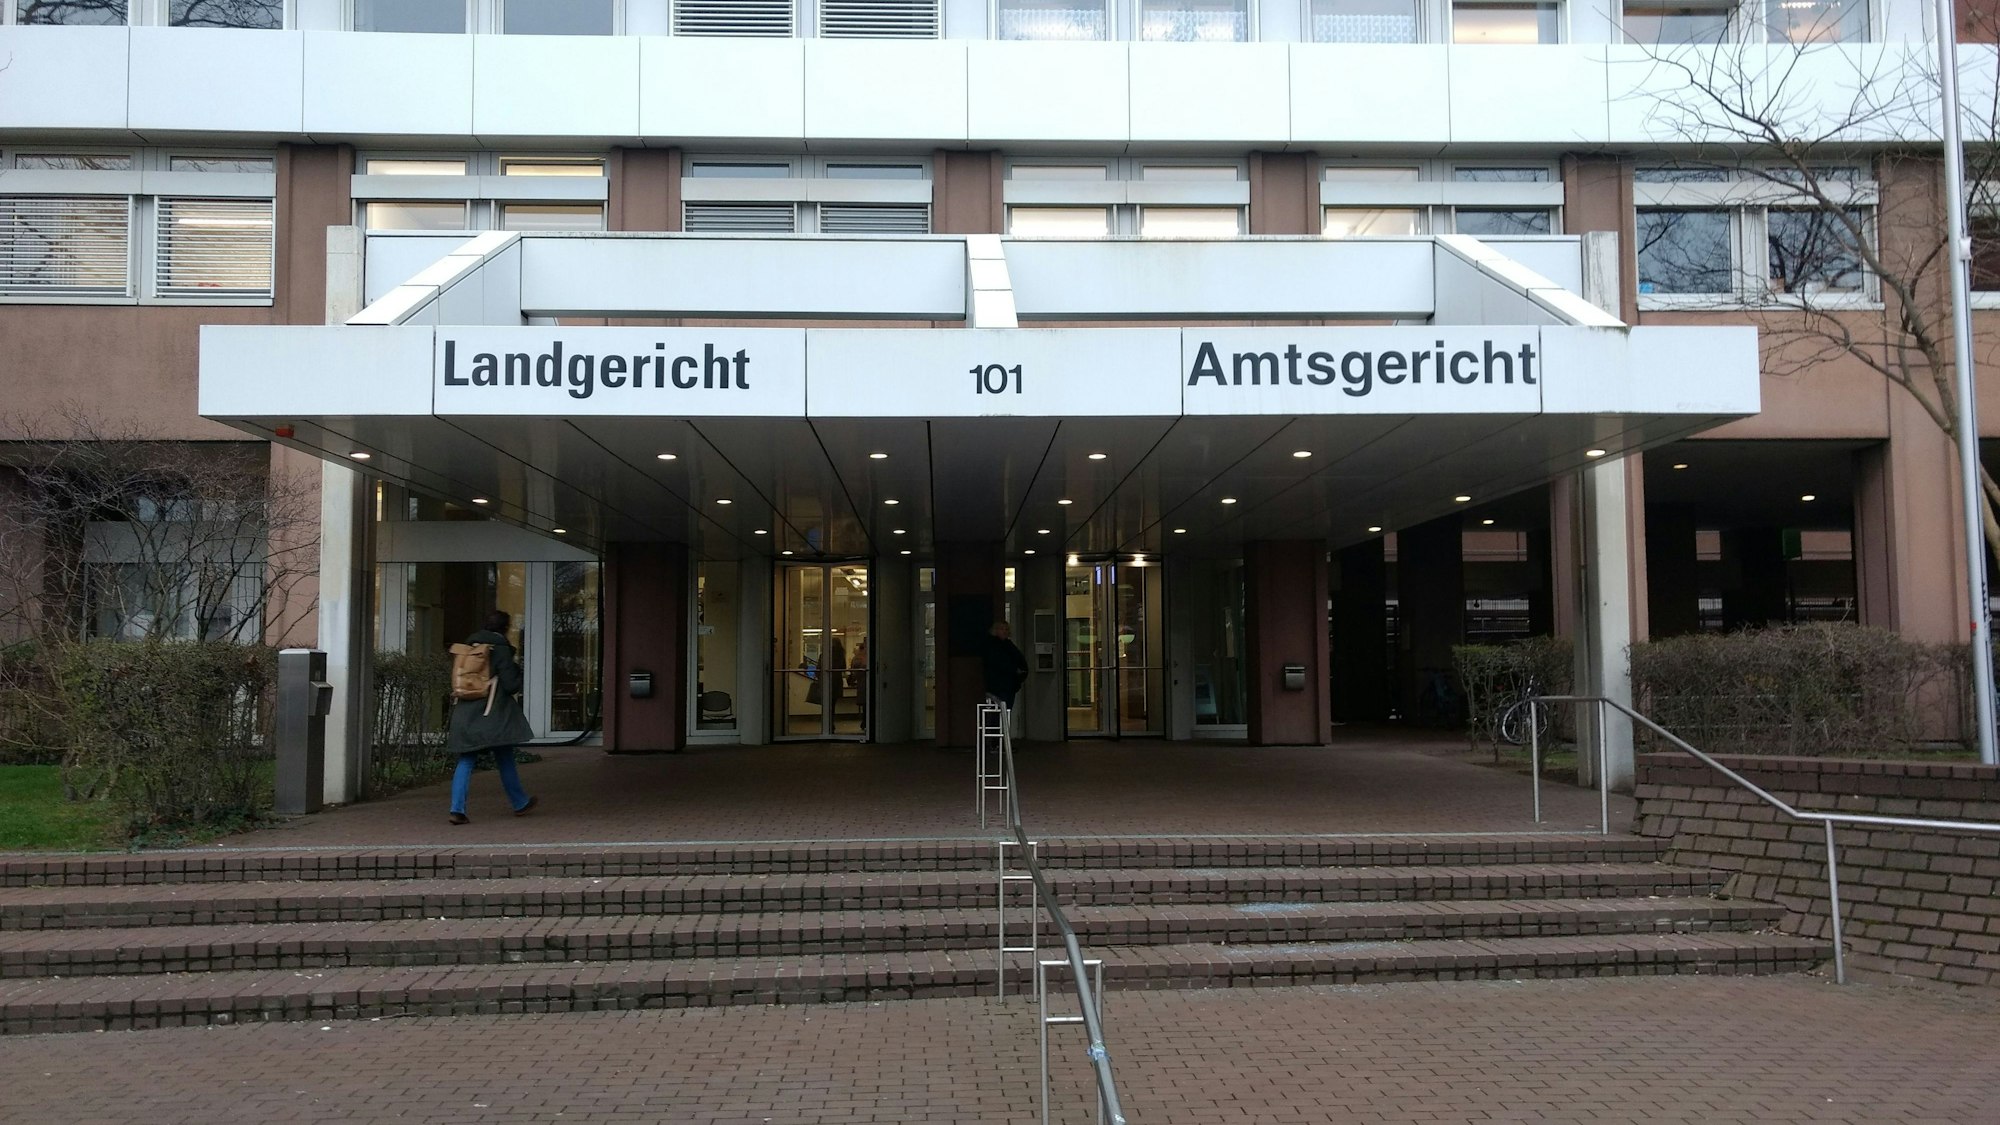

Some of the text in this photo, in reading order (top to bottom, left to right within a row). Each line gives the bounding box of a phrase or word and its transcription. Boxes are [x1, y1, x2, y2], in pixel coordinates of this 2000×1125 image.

[445, 341, 750, 399] Landgericht
[969, 364, 1022, 395] 101
[1187, 341, 1537, 398] Amtsgericht
